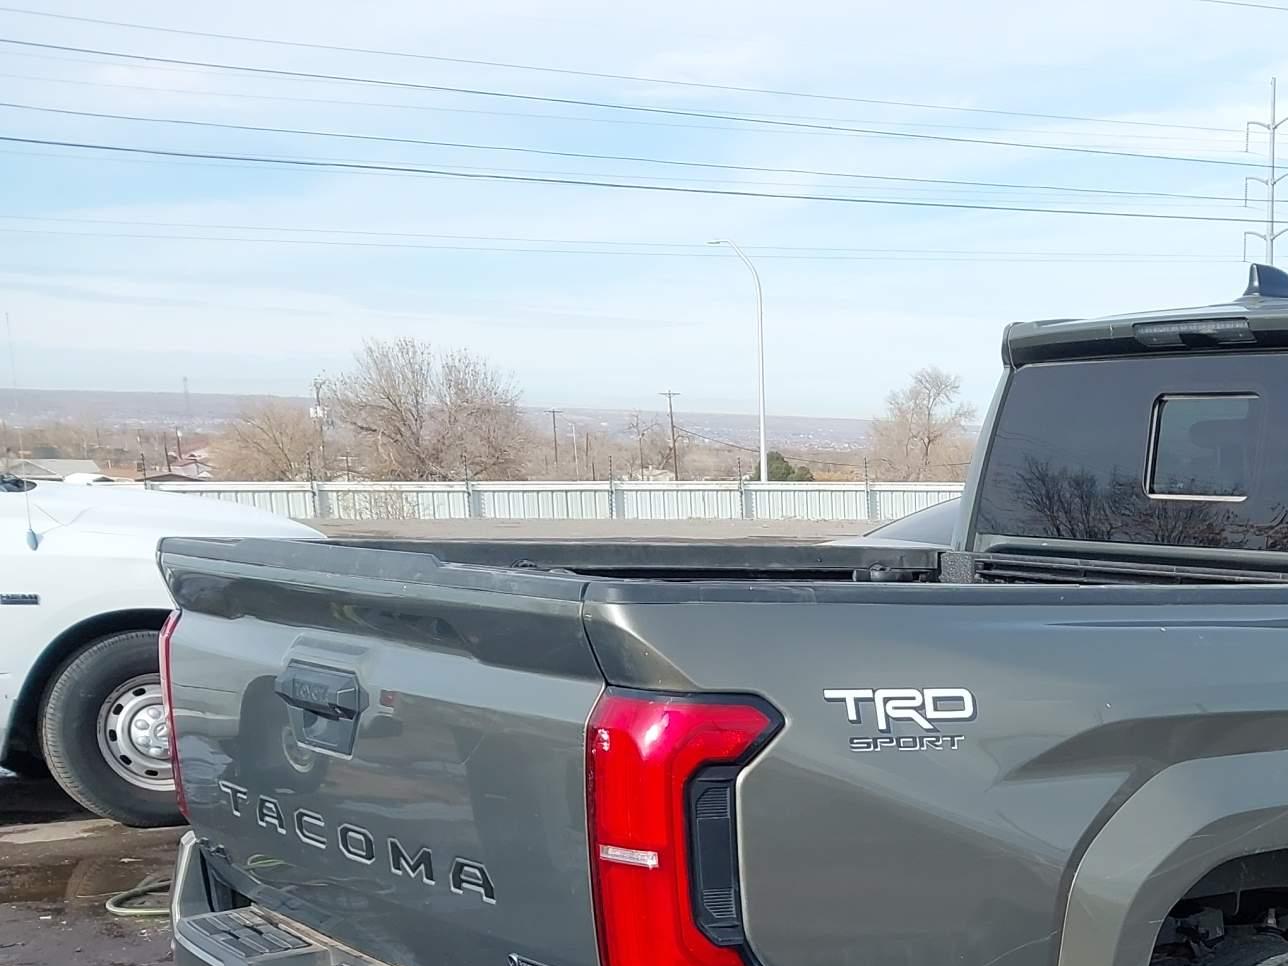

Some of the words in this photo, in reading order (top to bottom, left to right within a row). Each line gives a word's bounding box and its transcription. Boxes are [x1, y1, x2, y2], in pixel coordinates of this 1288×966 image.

[823, 688, 977, 733] TRD
[849, 735, 965, 752] SPORT
[218, 780, 497, 905] TACOMA
